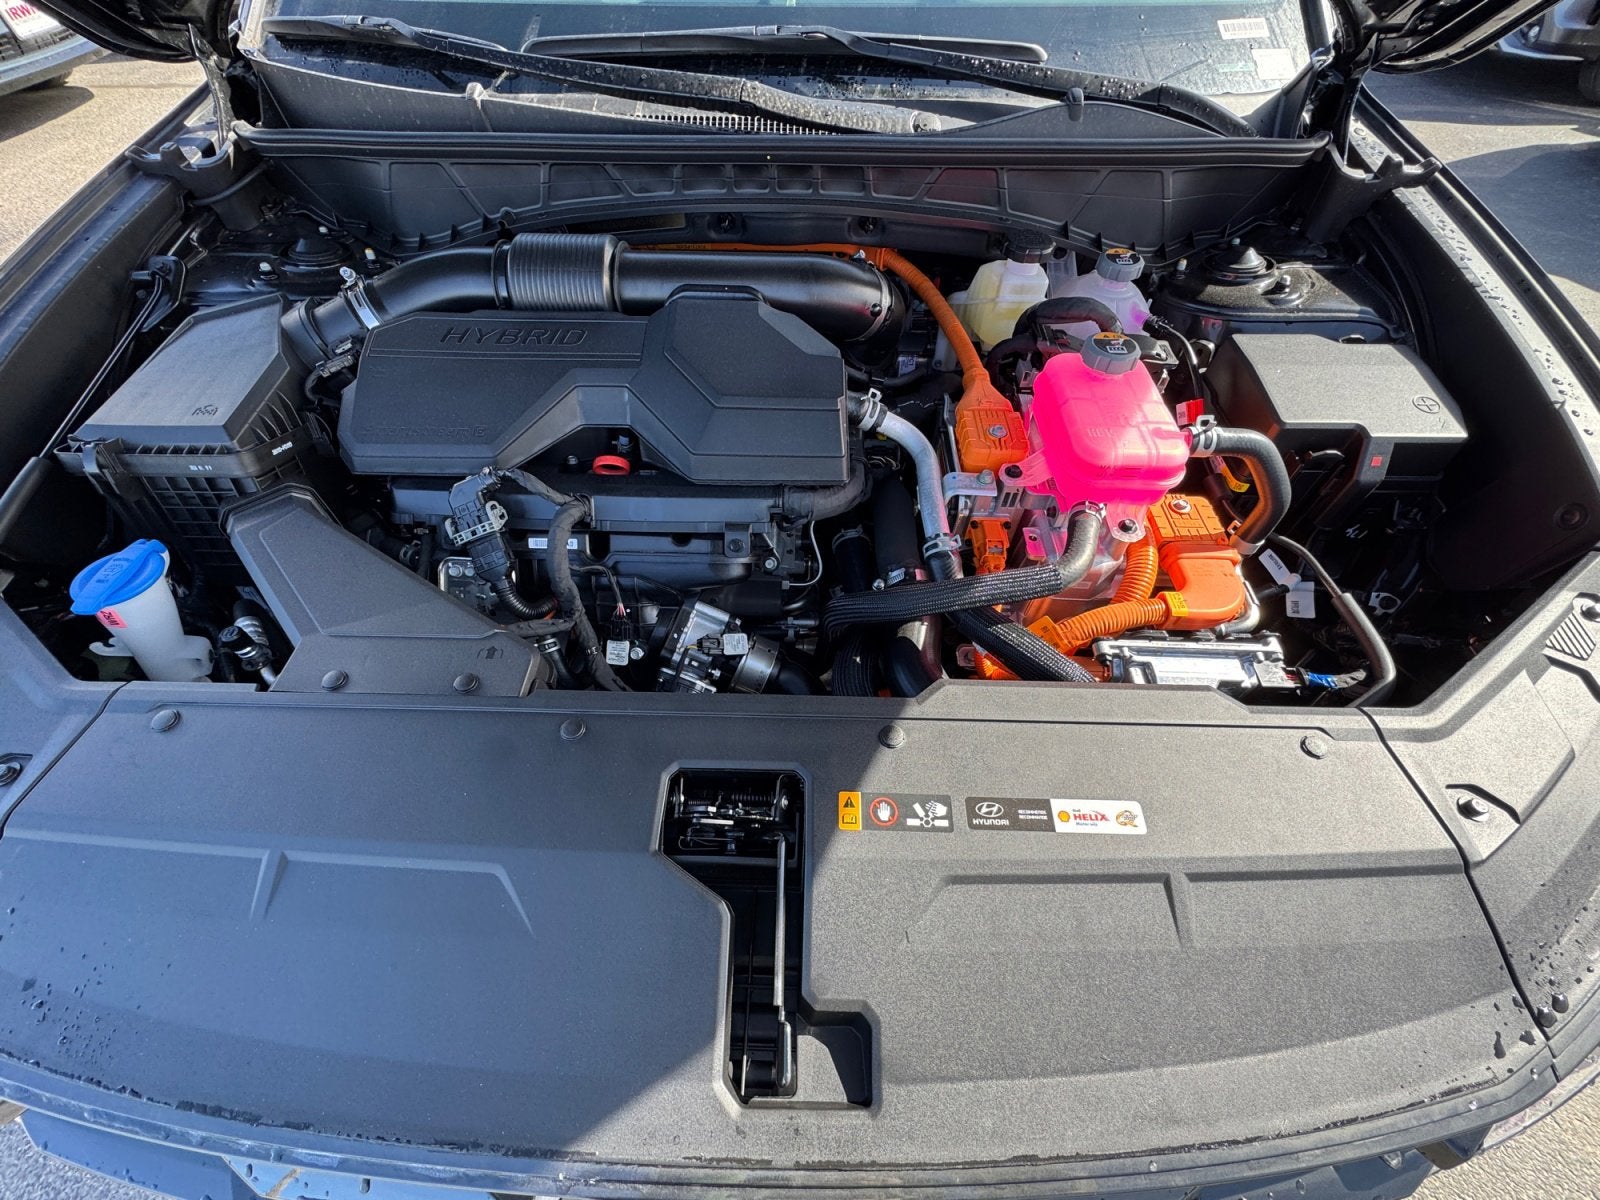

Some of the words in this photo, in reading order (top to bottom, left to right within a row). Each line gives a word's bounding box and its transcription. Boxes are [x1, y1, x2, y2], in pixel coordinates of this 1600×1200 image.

[439, 327, 588, 346] HYBRID
[972, 818, 1010, 826] HYUNDAI
[1073, 812, 1110, 822] HELIX
